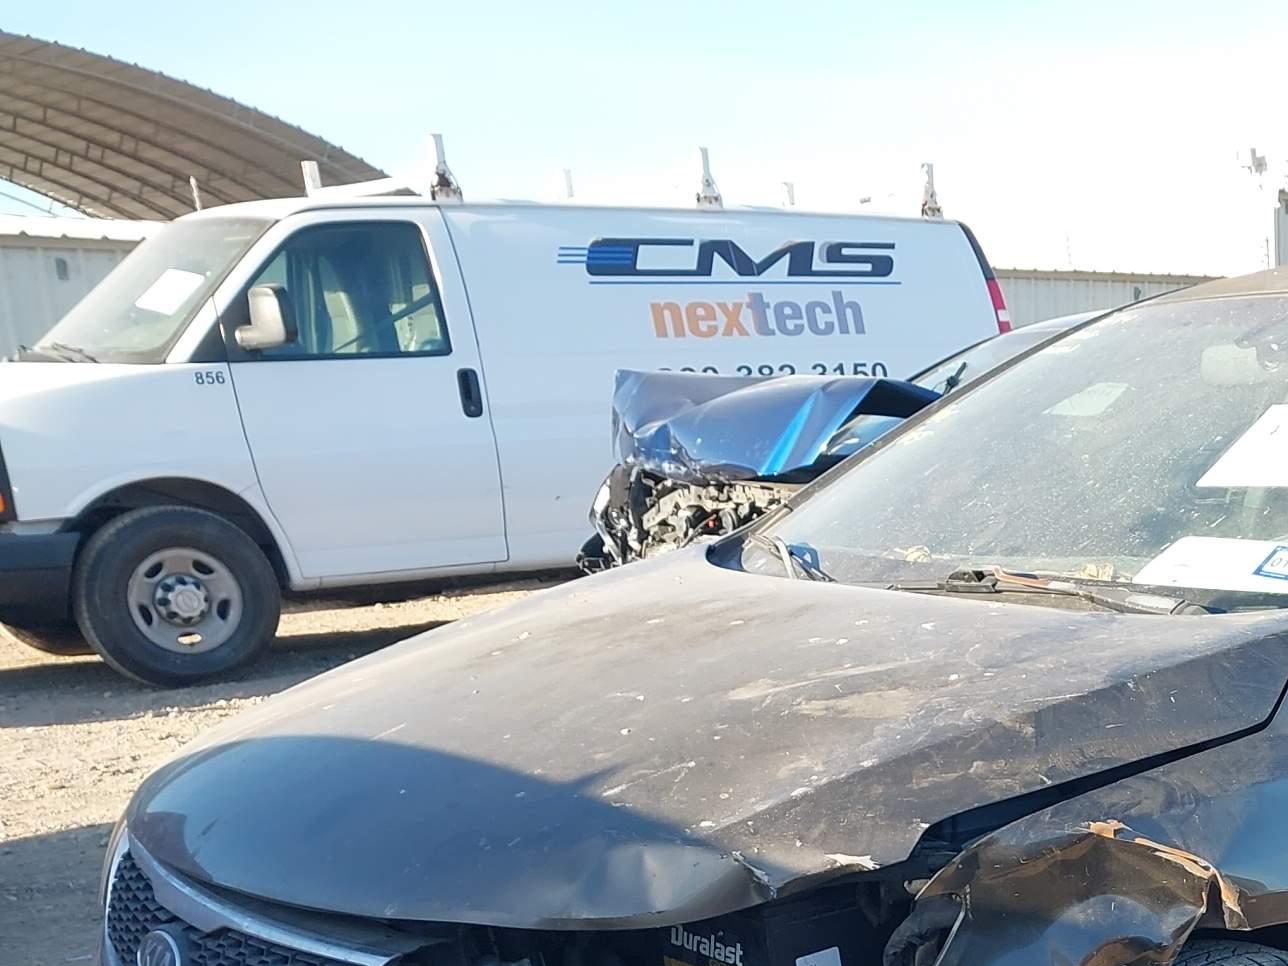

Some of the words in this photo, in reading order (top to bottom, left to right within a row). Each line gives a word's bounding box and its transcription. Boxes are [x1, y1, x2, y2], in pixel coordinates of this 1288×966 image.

[585, 237, 896, 278] CMS
[650, 290, 867, 339] nextech
[194, 370, 226, 385] 856
